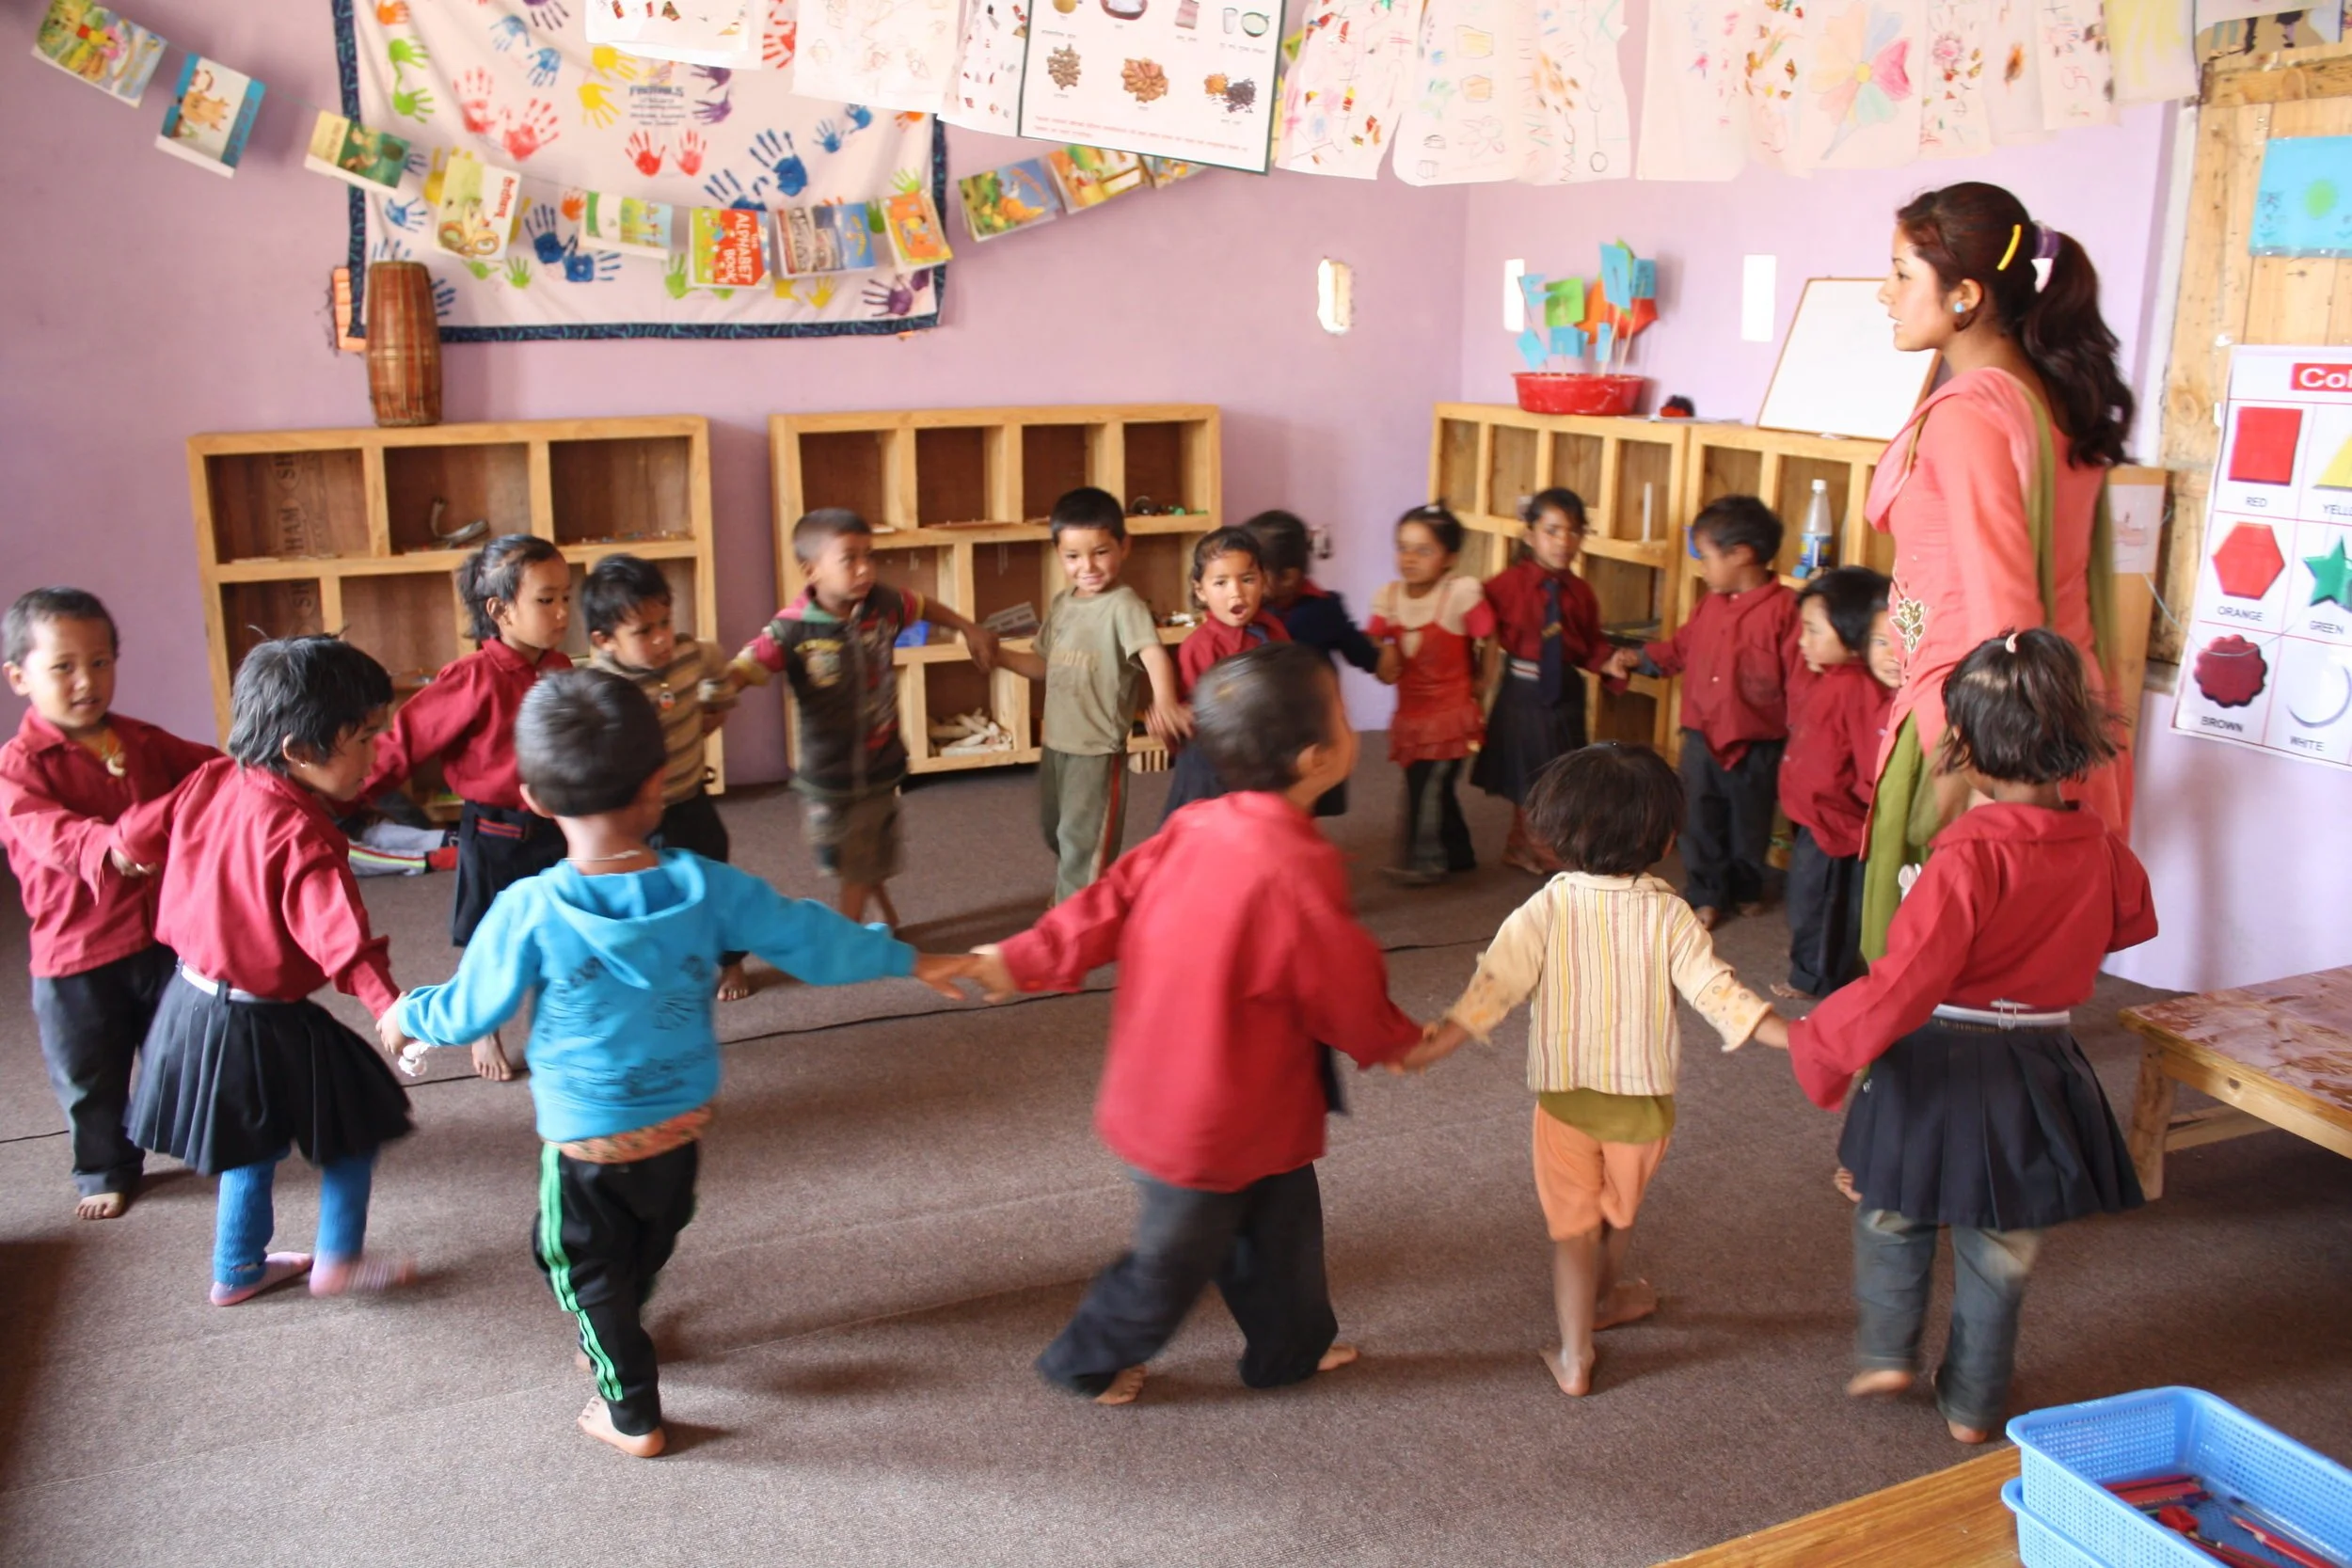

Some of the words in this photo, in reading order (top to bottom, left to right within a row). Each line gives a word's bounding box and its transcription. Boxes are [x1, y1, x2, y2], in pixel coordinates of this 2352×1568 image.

[735, 213, 755, 283] ALPHABET
[723, 248, 739, 283] BOOK
[2246, 496, 2267, 508] RED
[2323, 504, 2352, 517] YELL
[2217, 606, 2263, 622] ORANGE
[2310, 621, 2344, 635] GREEN
[2201, 716, 2244, 732] BROWN
[2290, 736, 2325, 752] WHITE
